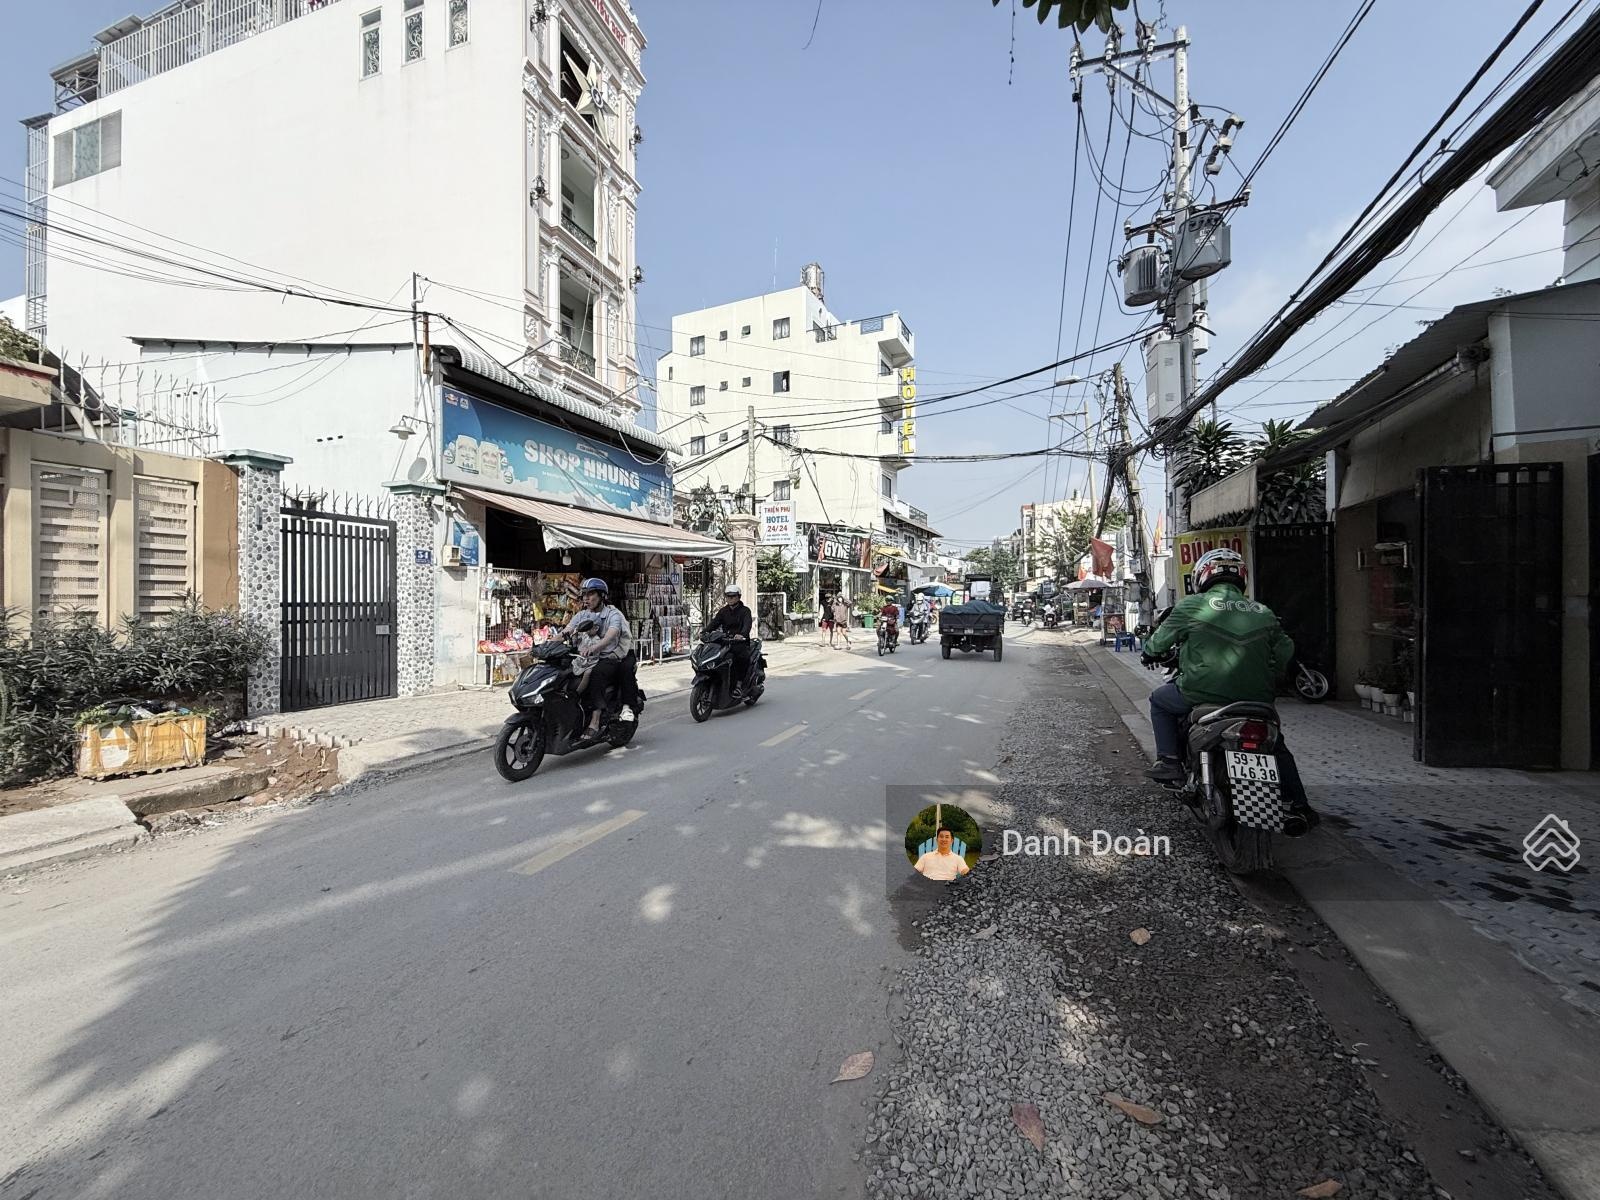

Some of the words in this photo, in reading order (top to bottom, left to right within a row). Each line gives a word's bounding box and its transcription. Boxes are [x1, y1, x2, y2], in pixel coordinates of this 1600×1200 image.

[902, 367, 915, 455] HOTEL
[524, 439, 581, 473] SHOP
[583, 457, 640, 490] NHUNG
[766, 515, 790, 524] HOTEL
[1209, 596, 1264, 614] Grab
[1233, 752, 1269, 768] 59-X1
[1230, 765, 1277, 782] 146.38
